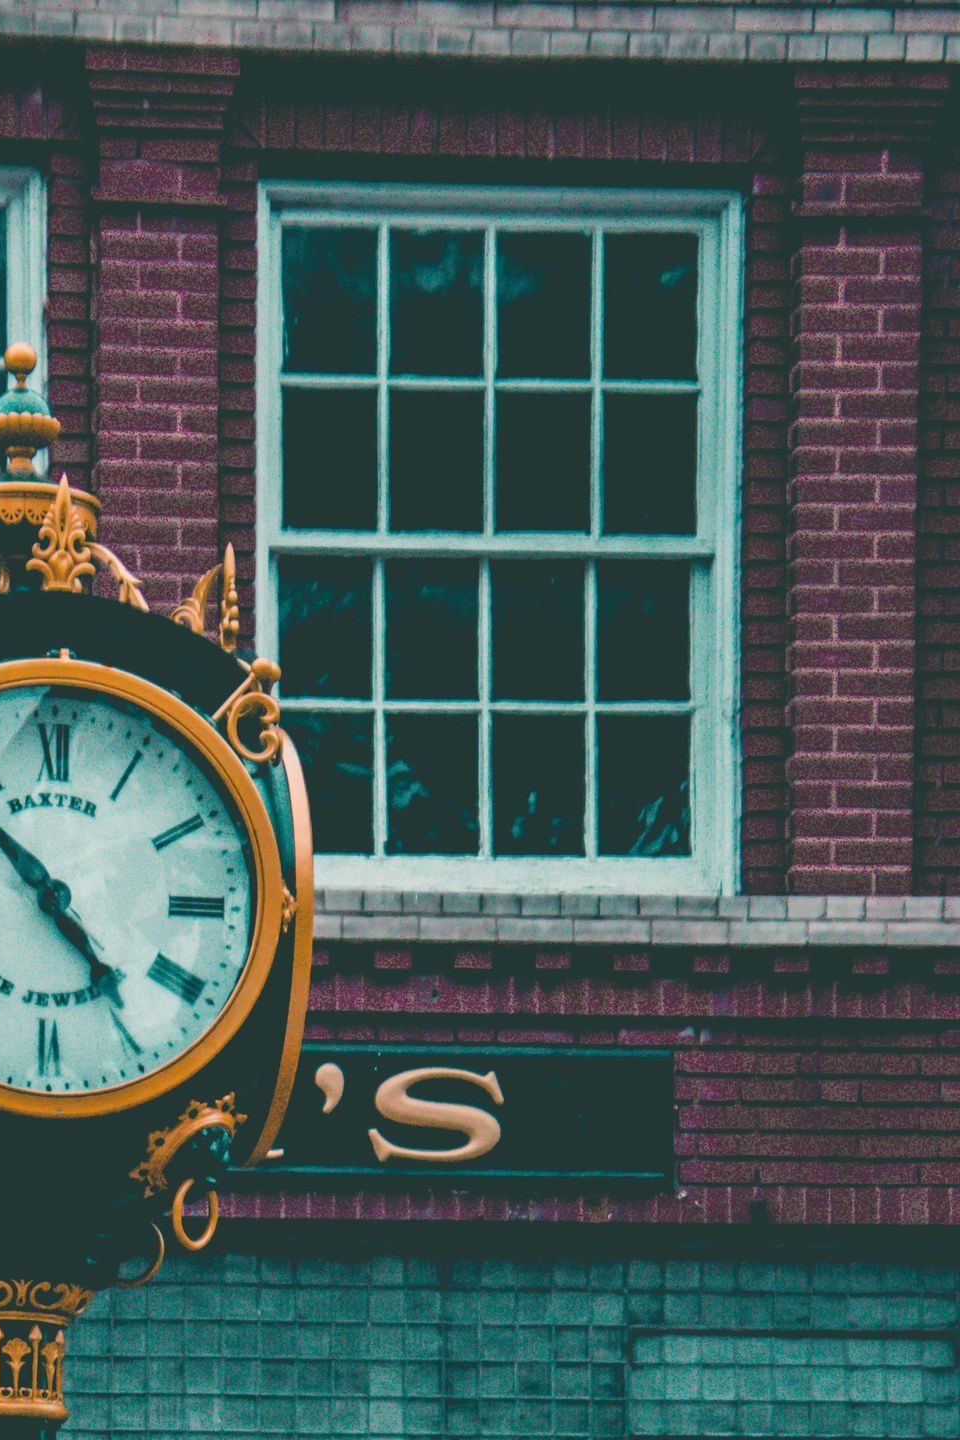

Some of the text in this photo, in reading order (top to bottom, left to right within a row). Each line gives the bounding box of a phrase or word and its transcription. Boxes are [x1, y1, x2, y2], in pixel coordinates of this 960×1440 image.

[38, 723, 70, 781] XII
[7, 792, 98, 818] BAXTER
[150, 813, 205, 852] II
[168, 893, 225, 920] III
[38, 1018, 61, 1077] VI
